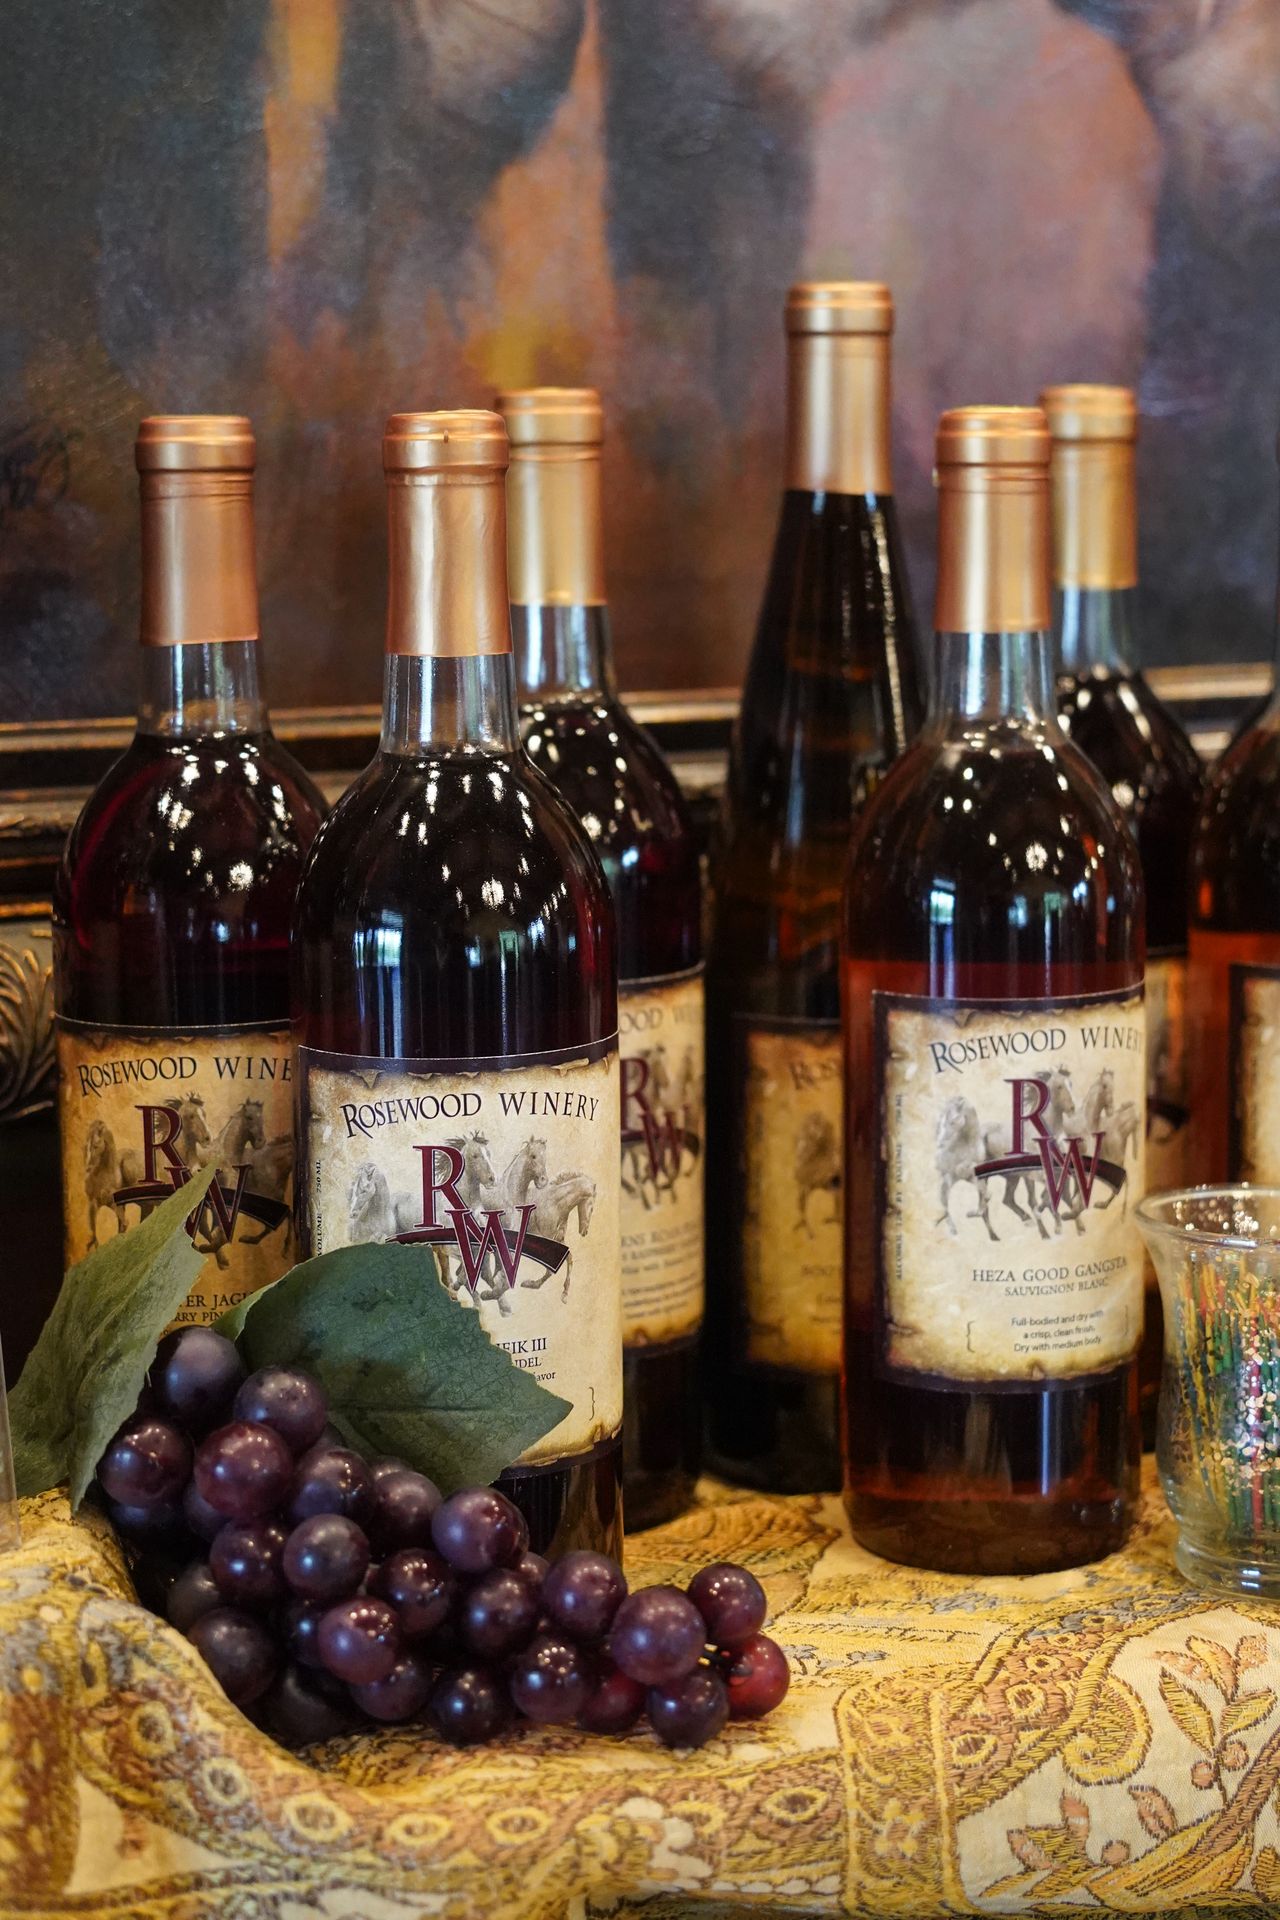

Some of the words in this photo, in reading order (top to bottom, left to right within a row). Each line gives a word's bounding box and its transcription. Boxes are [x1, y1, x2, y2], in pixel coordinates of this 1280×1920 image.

[929, 1028, 1067, 1074] ROSEWOOD
[77, 1056, 197, 1098] ROSEWOOD
[340, 1092, 482, 1139] ROSEWOOD
[498, 1091, 599, 1122] WINERY
[972, 1269, 1016, 1283] HEZA
[1022, 1267, 1070, 1282] GOOD
[1004, 1282, 1075, 1297] SAUVIGNON
[1078, 1276, 1109, 1292] BLANC
[1010, 1316, 1060, 1327] Full-bodied
[1060, 1314, 1075, 1324] and
[1013, 1342, 1030, 1354] Dry
[1031, 1341, 1051, 1352] with
[1052, 1338, 1083, 1350] medium
